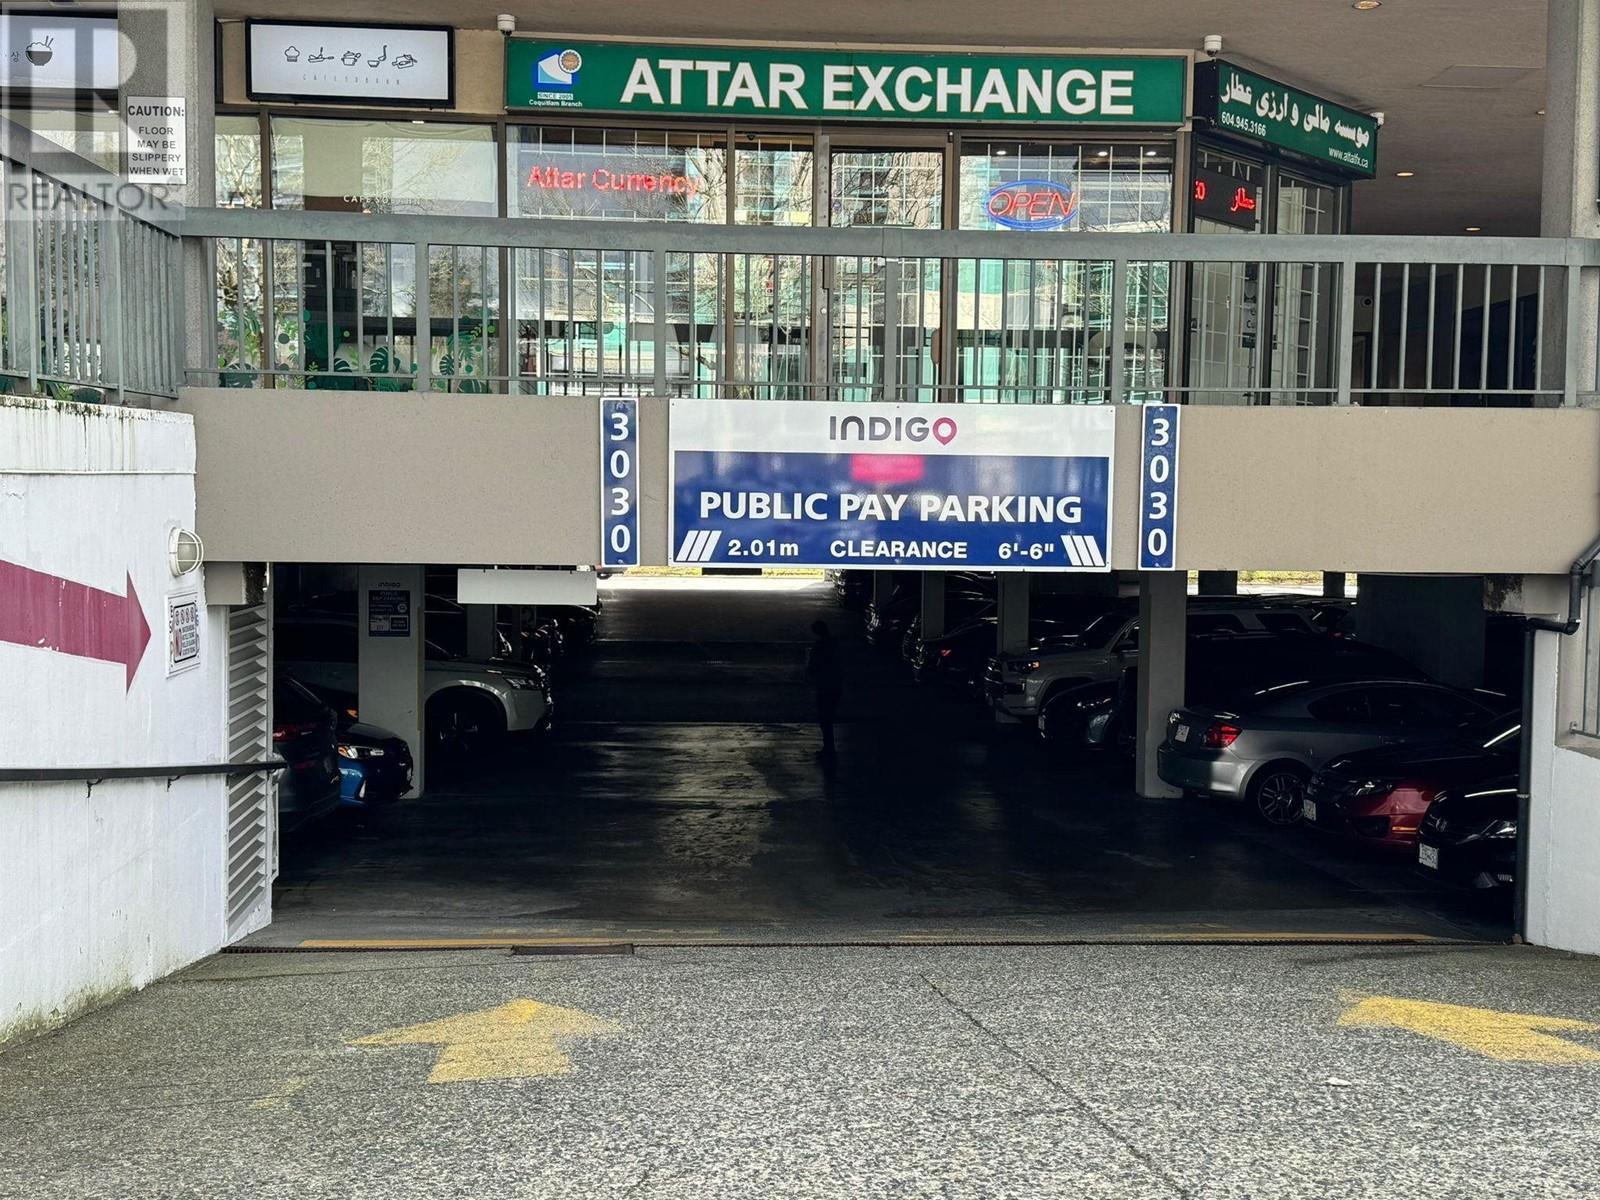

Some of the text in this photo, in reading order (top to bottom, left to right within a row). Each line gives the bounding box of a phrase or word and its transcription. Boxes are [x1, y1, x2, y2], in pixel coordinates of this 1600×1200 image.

[619, 57, 1135, 116] ATTAR EXCHANGE
[1221, 73, 1252, 105] عطار
[128, 105, 185, 117] CAUTION:
[138, 126, 174, 135] FLOOR
[137, 140, 177, 149] MAY BE
[131, 153, 181, 162] SLIPPERY
[129, 166, 185, 176] WHEN WET
[527, 165, 701, 199] Attar Currency
[988, 191, 1076, 216] OPEN
[609, 411, 632, 554] 3030
[1147, 417, 1170, 557] 3030
[699, 490, 1083, 524] PUBLIC PAY PARKING
[727, 539, 800, 557] 2.01m
[829, 540, 968, 559] CLEARANCE
